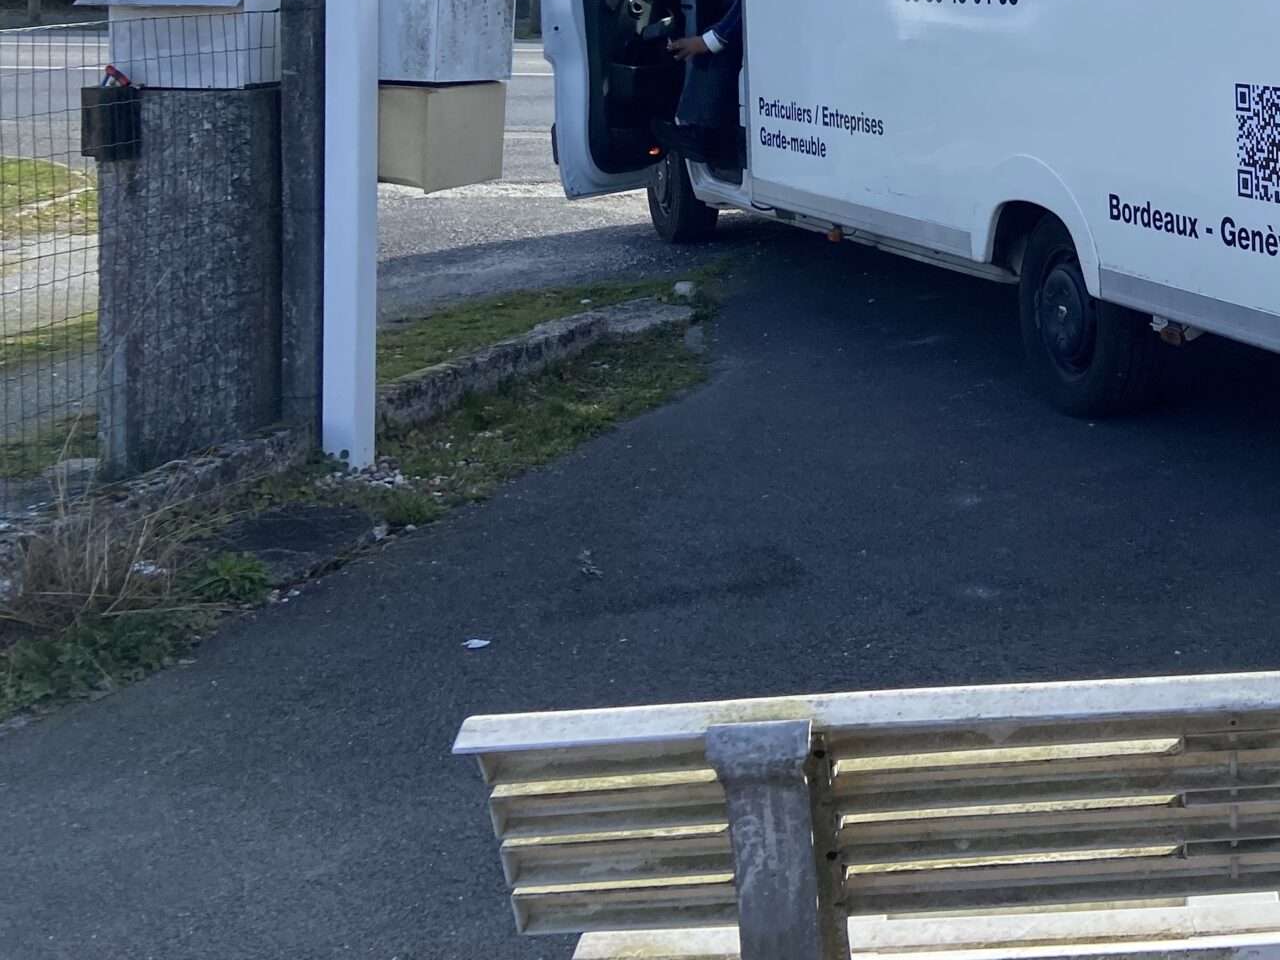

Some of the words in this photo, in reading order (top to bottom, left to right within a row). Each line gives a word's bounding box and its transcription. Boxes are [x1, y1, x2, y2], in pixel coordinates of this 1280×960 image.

[759, 97, 812, 124] Particuliers
[822, 106, 884, 136] Entreprises
[760, 127, 827, 158] Garde-meuble
[1108, 193, 1199, 239] Bordeaux
